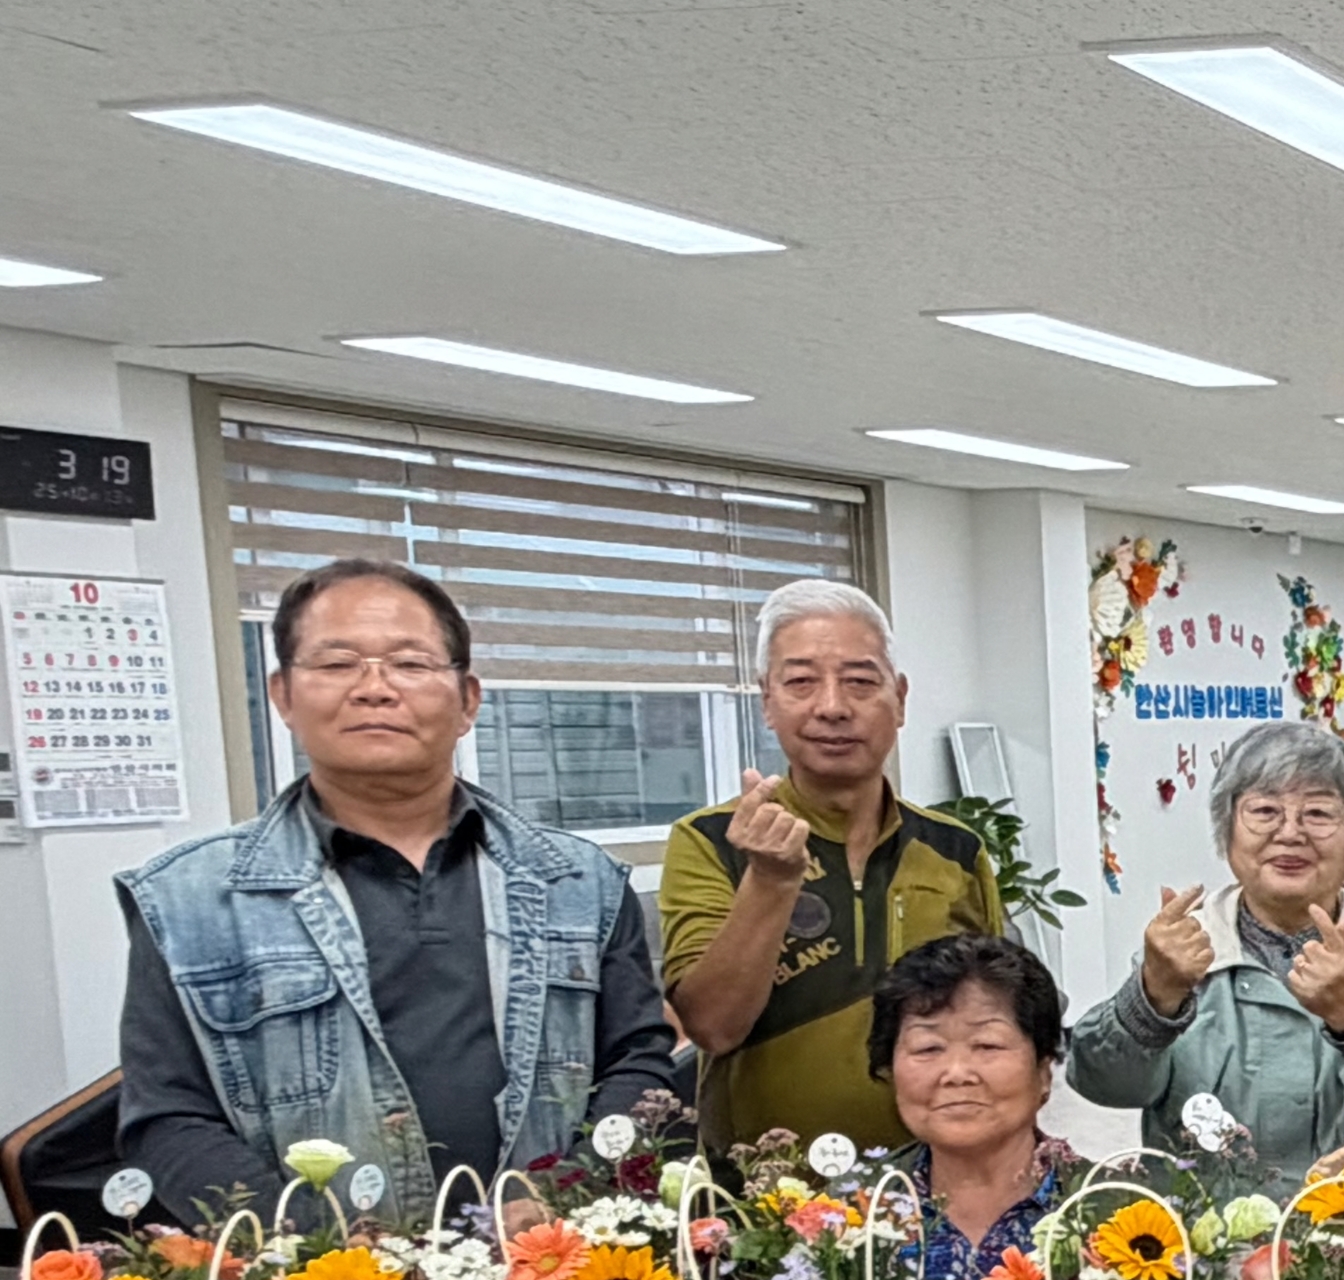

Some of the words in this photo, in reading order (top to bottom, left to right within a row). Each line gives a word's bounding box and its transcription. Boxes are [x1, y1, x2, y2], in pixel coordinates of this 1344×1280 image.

[58, 449, 77, 480] 3
[102, 455, 130, 485] 19
[70, 582, 99, 604] 10
[84, 627, 93, 639] 1
[105, 628, 115, 640] 2
[127, 629, 138, 641] 3
[149, 630, 158, 641] 4
[1157, 613, 1265, 659] 환영합니다
[22, 652, 32, 665] 5
[44, 653, 54, 666] 6
[65, 653, 75, 666] 7
[87, 655, 97, 667] 8
[108, 655, 119, 667] 9
[127, 656, 143, 667] 10
[149, 656, 164, 667] 11
[23, 680, 39, 693] 12
[44, 681, 60, 693] 13
[66, 681, 82, 693] 14
[87, 681, 104, 693] 15
[109, 682, 125, 693] 16
[130, 682, 145, 693] 17
[151, 683, 167, 695] 18
[25, 709, 43, 720] 19
[47, 708, 65, 720] 20
[69, 709, 86, 720] 21
[90, 709, 107, 720] 22
[111, 709, 128, 720] 23
[132, 709, 149, 720] 24
[154, 709, 170, 721] 25
[28, 736, 46, 748] 26
[50, 736, 67, 747] 27
[72, 736, 89, 747] 28
[93, 736, 110, 747] 29
[115, 736, 132, 747] 30
[137, 736, 152, 747] 31
[774, 937, 842, 986] BLANC
